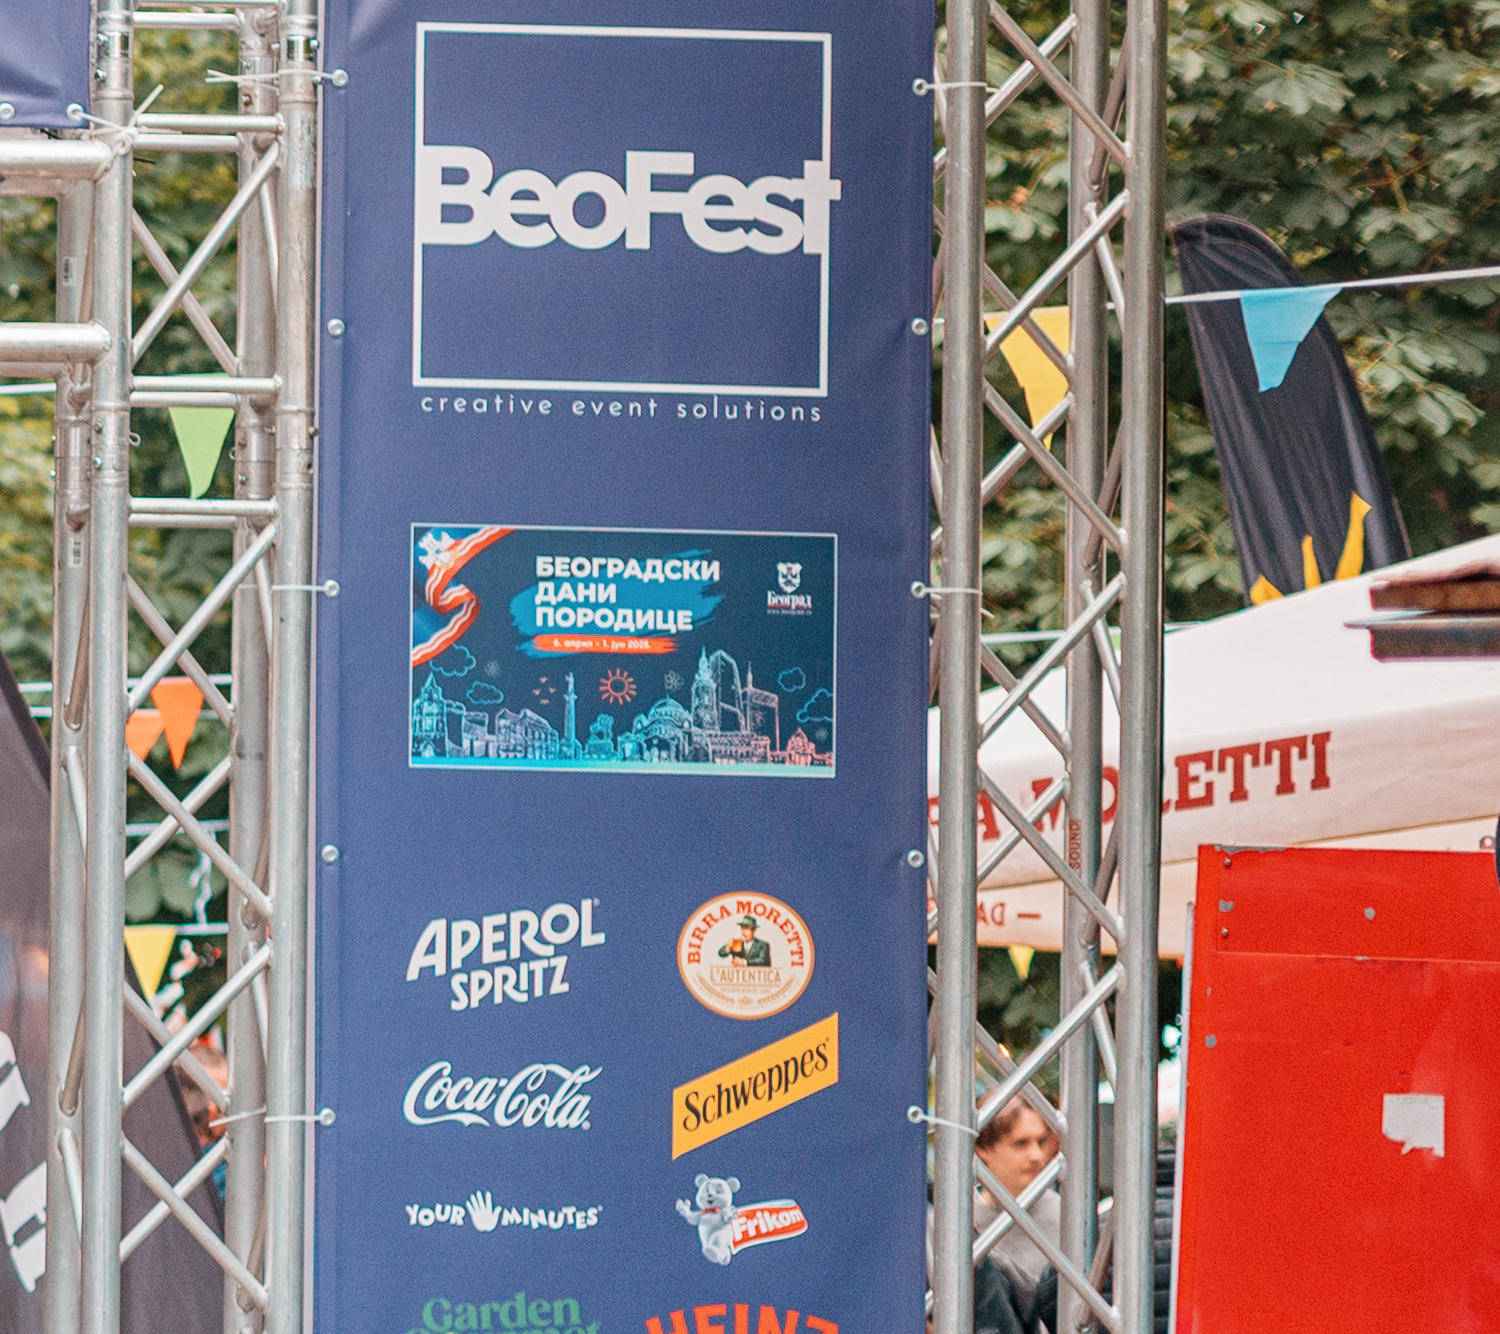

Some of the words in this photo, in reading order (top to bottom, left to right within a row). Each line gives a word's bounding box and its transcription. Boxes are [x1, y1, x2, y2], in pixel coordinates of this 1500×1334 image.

[415, 144, 842, 255] BeoFest
[420, 394, 553, 418] creative
[571, 399, 658, 419] event
[676, 397, 823, 424] solutions
[536, 555, 721, 582] БЕОГРАДСКИ
[535, 580, 617, 605] ДАНИ
[535, 606, 694, 634] ПОРОДИЦЕ
[406, 898, 606, 982] APEROL
[687, 905, 734, 965] BIRRA
[735, 899, 804, 968] MORETTI
[451, 955, 571, 1012] SPRITZ
[710, 966, 782, 985] L'AUTENTICA
[403, 1060, 604, 1130] Coca-Cola
[683, 1040, 830, 1134] Schweppes
[405, 1203, 466, 1227] YOUR
[501, 1206, 599, 1230] MINUTES
[732, 1207, 804, 1242] Frikom
[421, 1291, 582, 1334] Garden
